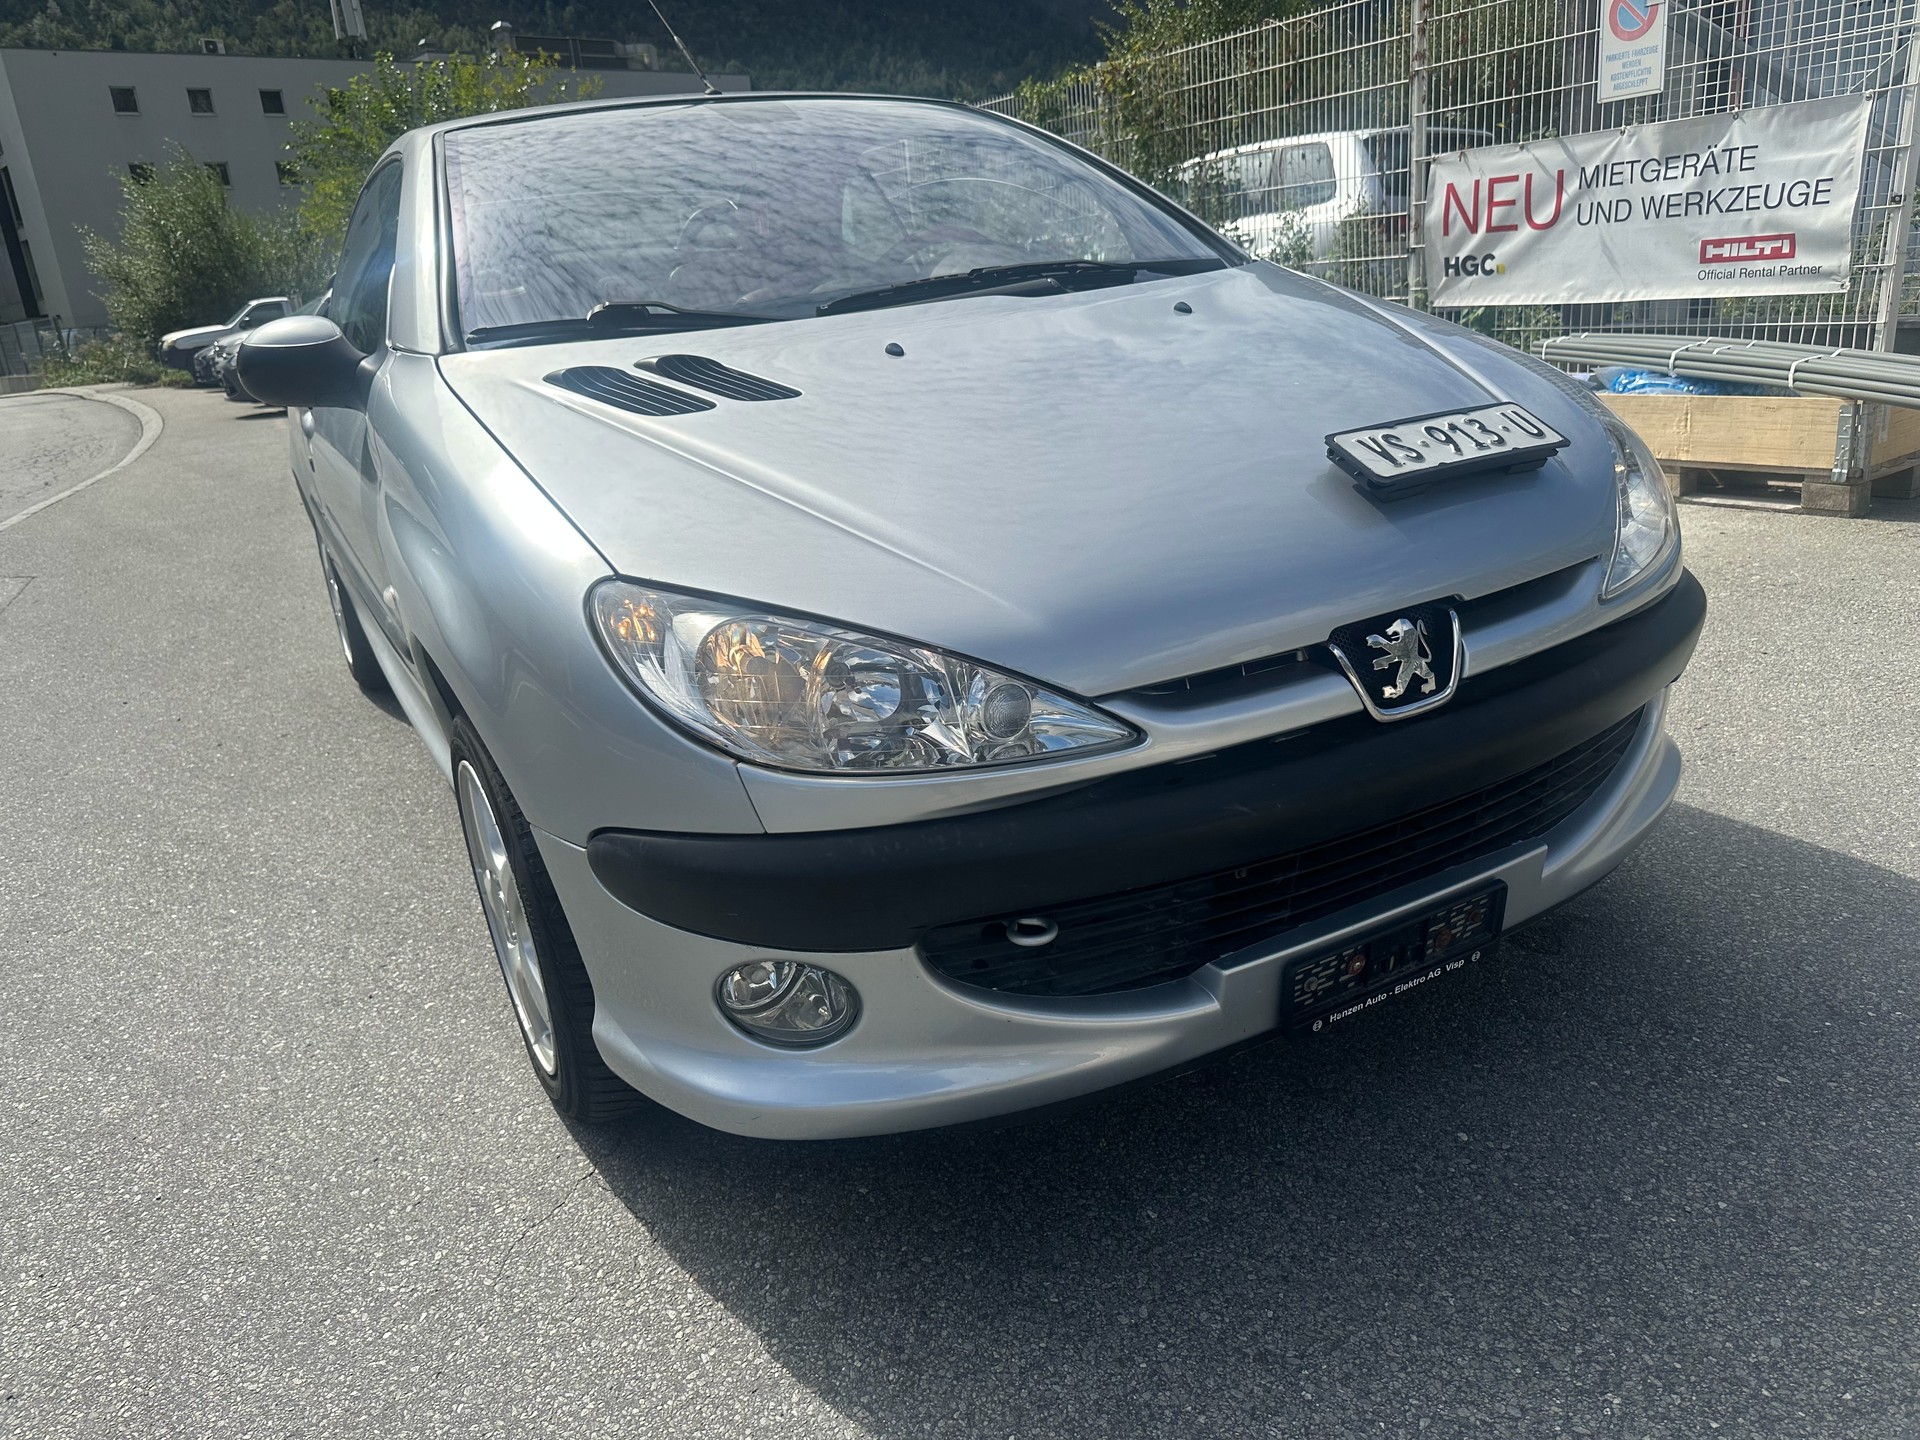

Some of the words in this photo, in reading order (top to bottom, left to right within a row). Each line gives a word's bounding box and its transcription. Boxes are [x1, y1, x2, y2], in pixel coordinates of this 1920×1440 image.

[1606, 50, 1631, 63] PARKIERTE
[1631, 45, 1659, 58] FAHRZEUGE
[1622, 58, 1642, 69] WERDEN
[1610, 66, 1652, 82] KOSTENPFLICHTIG
[1613, 77, 1649, 91] ABGESCHLEPPT
[1578, 145, 1759, 190] MIETGERÄTE
[1442, 169, 1564, 237] NEU
[1577, 199, 1633, 227] UND
[1641, 178, 1834, 221] WERKZEUGE
[1705, 239, 1790, 258] HILTI
[1697, 268, 1736, 281] Official
[1739, 266, 1776, 279] Rental
[1780, 265, 1823, 276] Partner
[1365, 993, 1387, 1008] Auto
[1394, 976, 1426, 995] Elektro
[1427, 968, 1441, 980] AG
[1446, 959, 1465, 972] Visp
